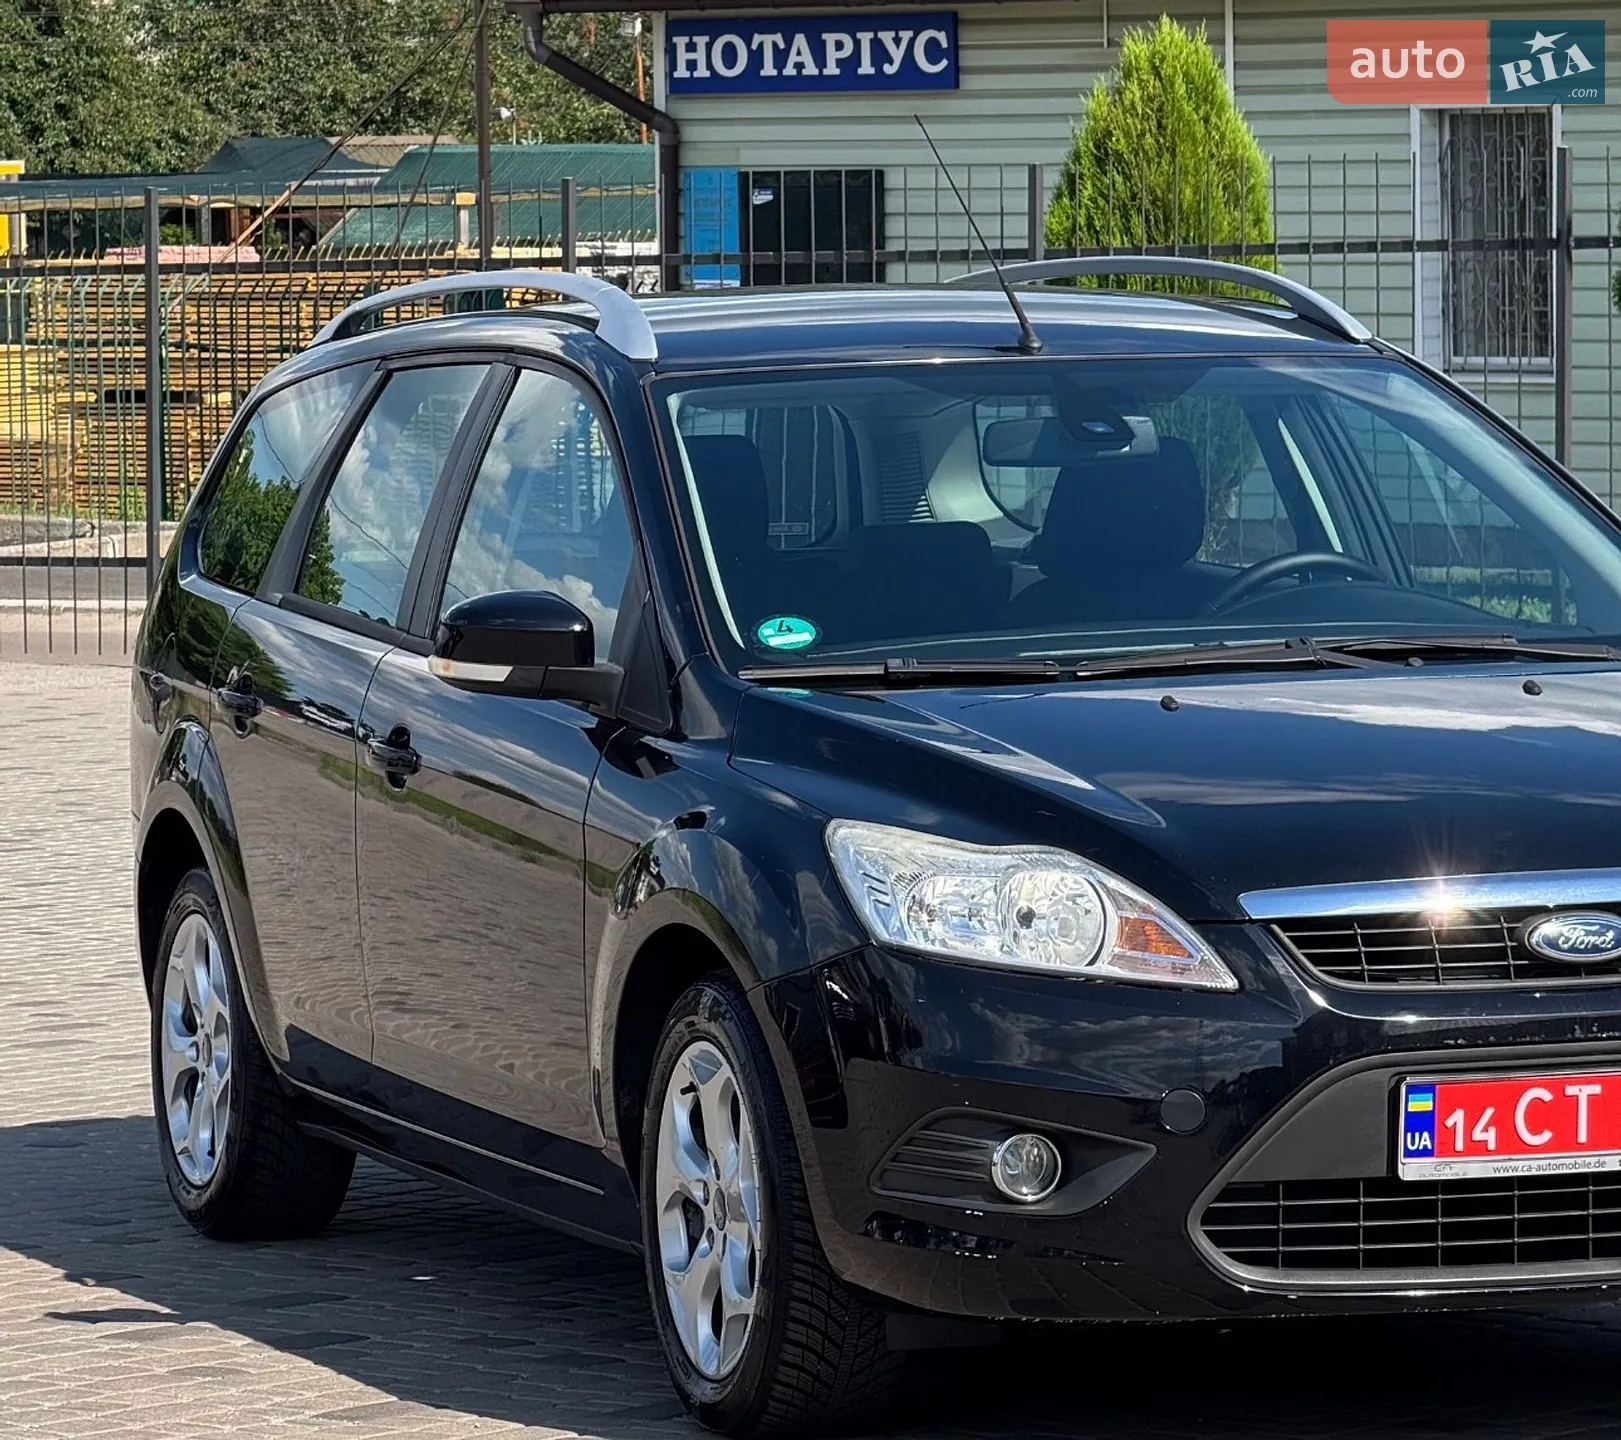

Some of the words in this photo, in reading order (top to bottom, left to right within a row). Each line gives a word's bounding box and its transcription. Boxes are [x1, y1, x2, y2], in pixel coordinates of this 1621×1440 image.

[672, 29, 949, 78] НОТАРІУС
[1558, 924, 1615, 949] Ford
[1444, 1107, 1496, 1152] 14
[1514, 1084, 1602, 1146] CT
[1407, 1131, 1432, 1150] UA
[1492, 1158, 1607, 1175] www.ca-automobile.de
